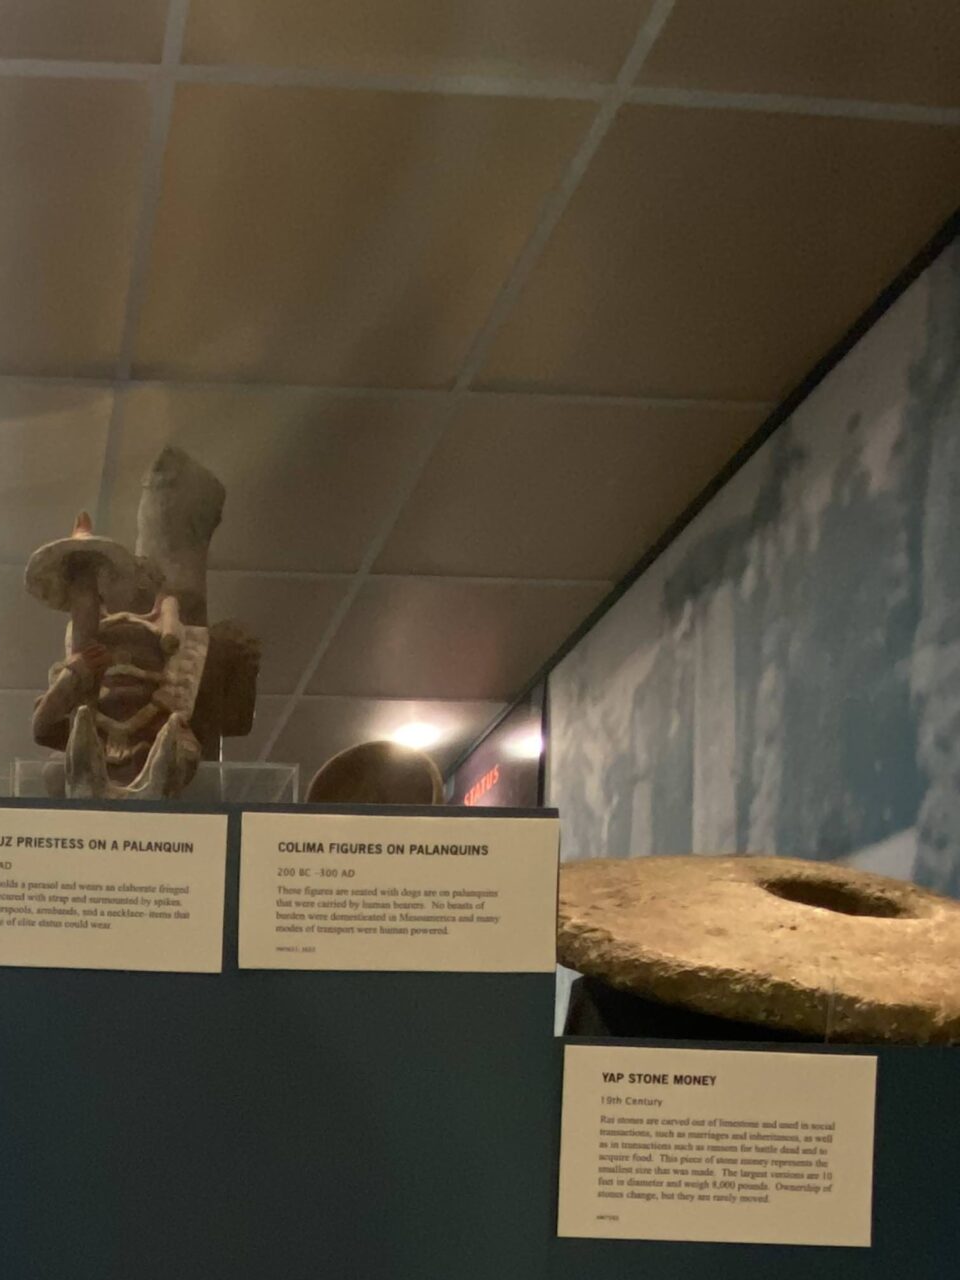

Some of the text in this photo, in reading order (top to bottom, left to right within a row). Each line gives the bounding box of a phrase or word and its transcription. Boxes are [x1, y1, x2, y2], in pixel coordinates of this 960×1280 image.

[463, 764, 499, 804] STATUS
[17, 836, 85, 851] PRIESTESS
[88, 840, 107, 851] ON
[111, 841, 119, 851] A
[123, 840, 194, 855] PALANQUIN
[278, 842, 489, 858] COLIMA FIGURES ON PALANQUINS
[278, 867, 296, 878] 200
[299, 868, 310, 878] BC
[342, 869, 355, 878] AD
[602, 1073, 716, 1088] YAP STONE MONEY
[601, 1095, 664, 1109] 19th Century
